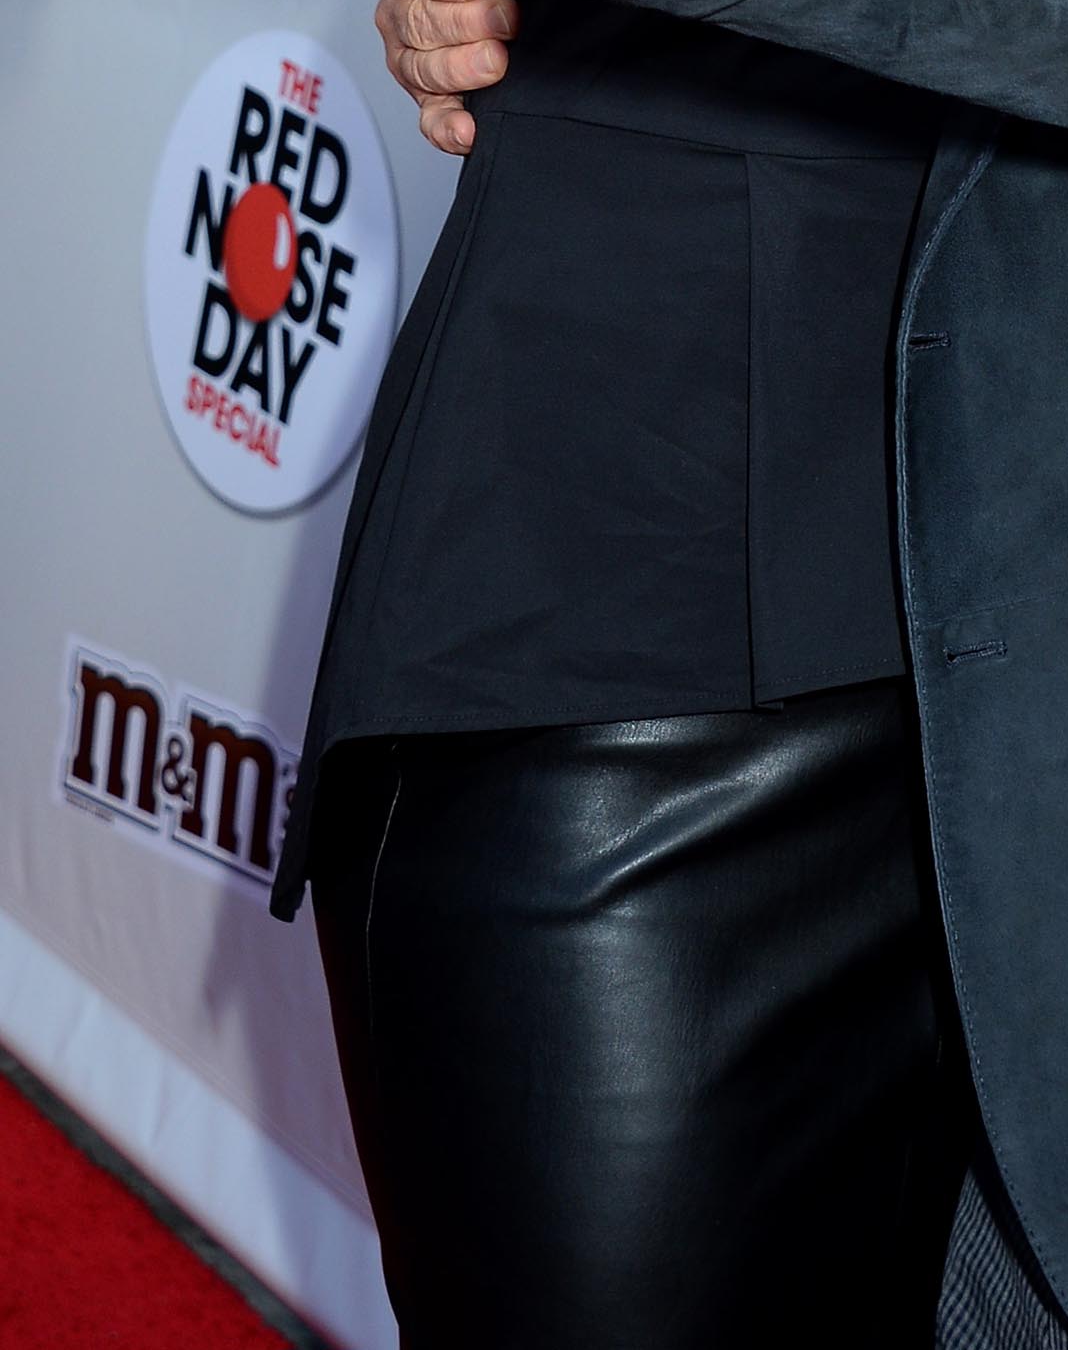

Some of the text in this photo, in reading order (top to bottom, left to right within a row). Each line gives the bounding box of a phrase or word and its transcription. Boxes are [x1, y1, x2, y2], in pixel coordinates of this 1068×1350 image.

[279, 59, 325, 115] THE
[229, 84, 351, 226] RED
[192, 280, 316, 425] DAY
[184, 376, 281, 468] SPECIAL
